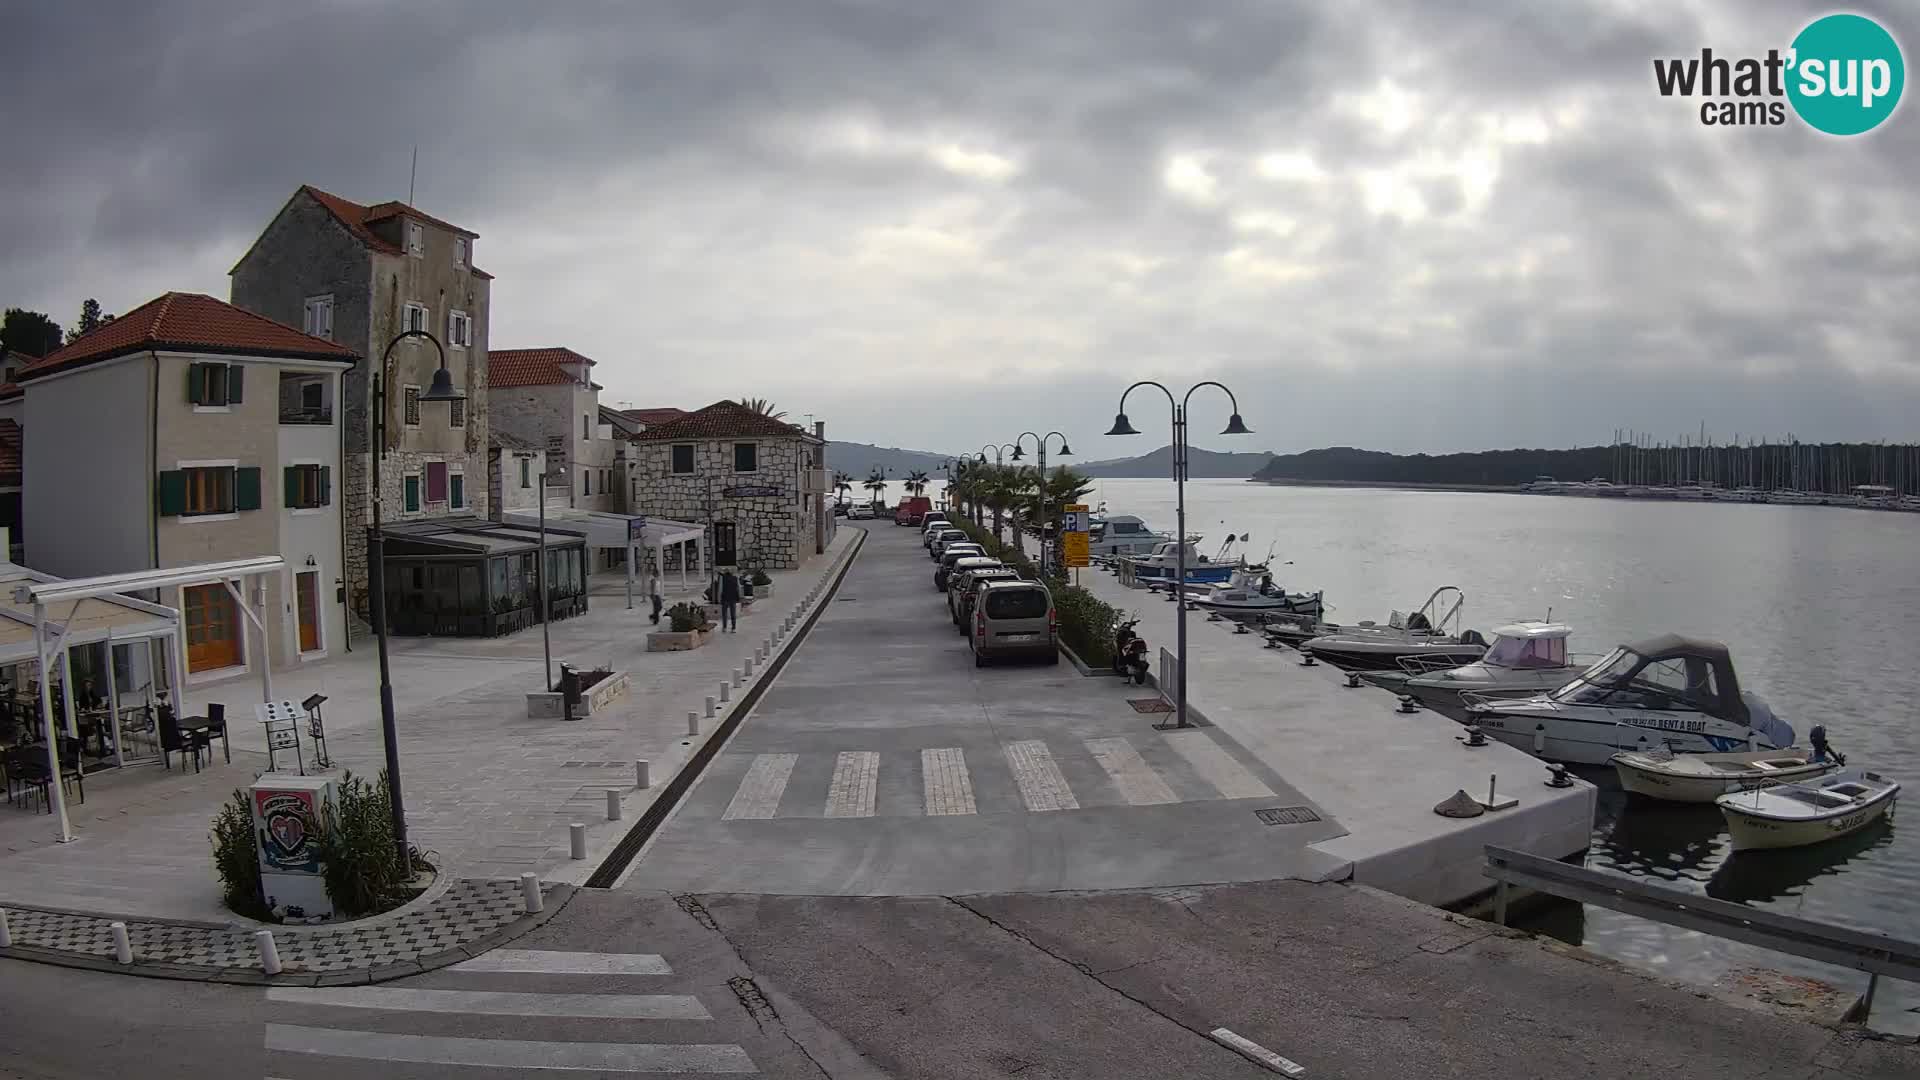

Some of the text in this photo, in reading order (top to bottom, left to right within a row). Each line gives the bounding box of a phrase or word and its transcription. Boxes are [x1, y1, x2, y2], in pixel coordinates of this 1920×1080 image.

[1066, 514, 1076, 530] P
[1658, 719, 1679, 729] RENT
[1680, 720, 1686, 730] A
[1686, 721, 1707, 732] BOAT
